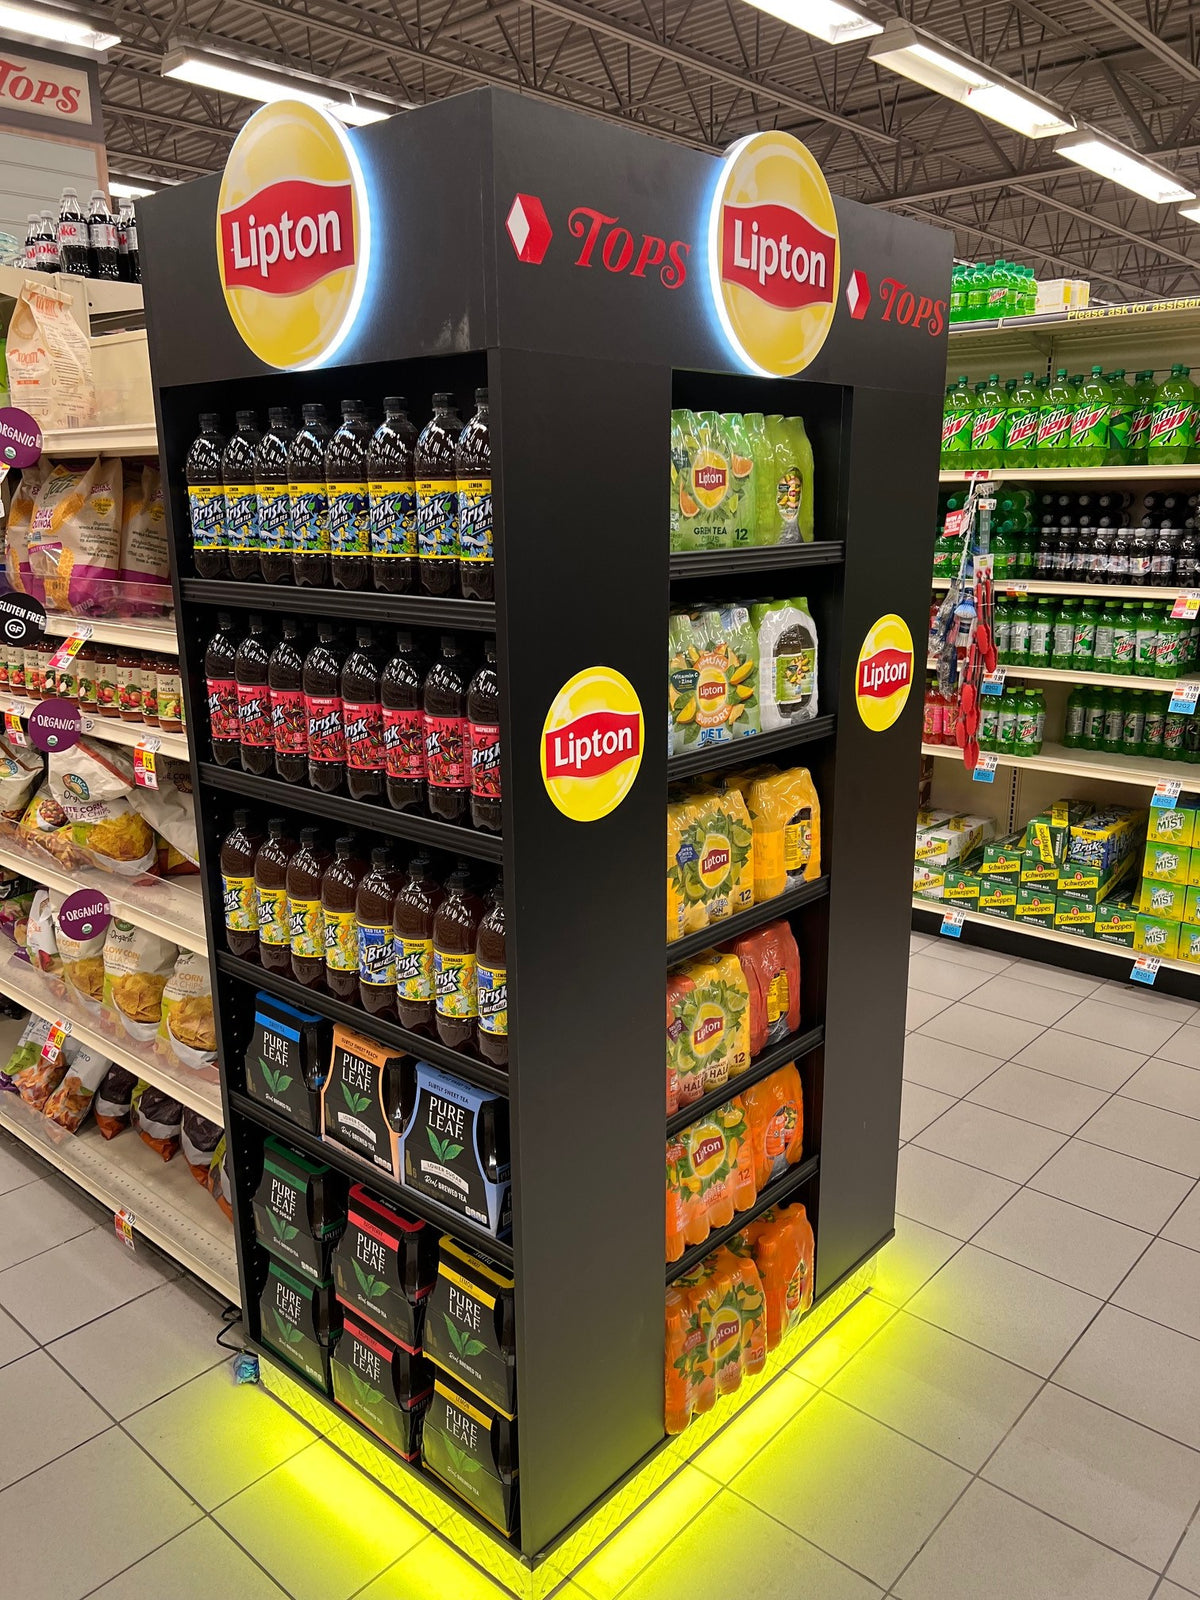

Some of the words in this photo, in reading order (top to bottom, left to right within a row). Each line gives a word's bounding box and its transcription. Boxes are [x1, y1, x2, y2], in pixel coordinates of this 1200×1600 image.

[230, 208, 342, 278] Lipton
[567, 206, 691, 290] TOPS
[733, 218, 826, 288] Lipton
[878, 277, 948, 337] TOPS
[1067, 310, 1105, 320] Please
[1108, 307, 1129, 316] ask
[1132, 304, 1150, 313] for
[279, 513, 288, 521] TEA
[387, 516, 395, 525] TEA
[436, 516, 445, 525] TEA
[475, 520, 485, 530] ICED
[713, 527, 727, 535] TEA
[735, 528, 748, 540] 12
[26, 611, 45, 624] FREE
[9, 624, 22, 634] GF
[672, 673, 693, 681] Vitamin
[863, 659, 907, 690] Lipton
[700, 685, 723, 697] Lipton
[37, 715, 74, 730] ORGANIC
[697, 709, 730, 724] SUPPORT
[701, 728, 724, 741] DIET
[554, 727, 632, 769] Lipton
[80, 803, 103, 813] CORN
[1156, 817, 1184, 831] MIST
[917, 845, 942, 857] Schweppes
[704, 853, 727, 870] Lpton
[988, 863, 1017, 871] Schweppes
[1155, 857, 1178, 870] MIST
[1025, 871, 1055, 879] Schweppes
[914, 878, 940, 889] Schweppes
[1064, 879, 1094, 888] Schweppes
[739, 889, 752, 903] 12
[949, 888, 975, 897] Schweppes
[984, 897, 1012, 905] Schweppes
[1151, 894, 1174, 907] MIST
[66, 902, 103, 922] ORGANIC
[1021, 905, 1051, 913] Schweppes
[1060, 913, 1090, 922] Schweppes
[1100, 923, 1132, 932] Schweppes
[62, 939, 81, 949] CORN
[1145, 932, 1167, 944] MIST
[123, 950, 139, 959] CORN
[367, 942, 393, 963] Bris
[179, 973, 204, 983] CORN
[263, 1031, 289, 1054] PURE
[733, 1052, 745, 1064] 12
[343, 1053, 372, 1079] PURE
[428, 1081, 444, 1092] SUBTLY
[444, 1088, 459, 1100] SWEET
[459, 1095, 469, 1103] TEA
[430, 1096, 465, 1125] PURE
[427, 1163, 444, 1174] LOWER
[445, 1169, 462, 1184] SUGAR
[739, 1168, 750, 1181] 12
[271, 1179, 297, 1205] PURE
[424, 1174, 438, 1189] Real
[438, 1183, 458, 1198] BREWED
[458, 1192, 468, 1203] TEA
[357, 1232, 386, 1262] PURE
[459, 1276, 473, 1290] LEMON
[277, 1282, 302, 1309] PURE
[450, 1287, 481, 1320] PURE
[353, 1340, 381, 1371] PURE
[474, 1370, 482, 1381] TEA
[446, 1405, 478, 1439] PURE
